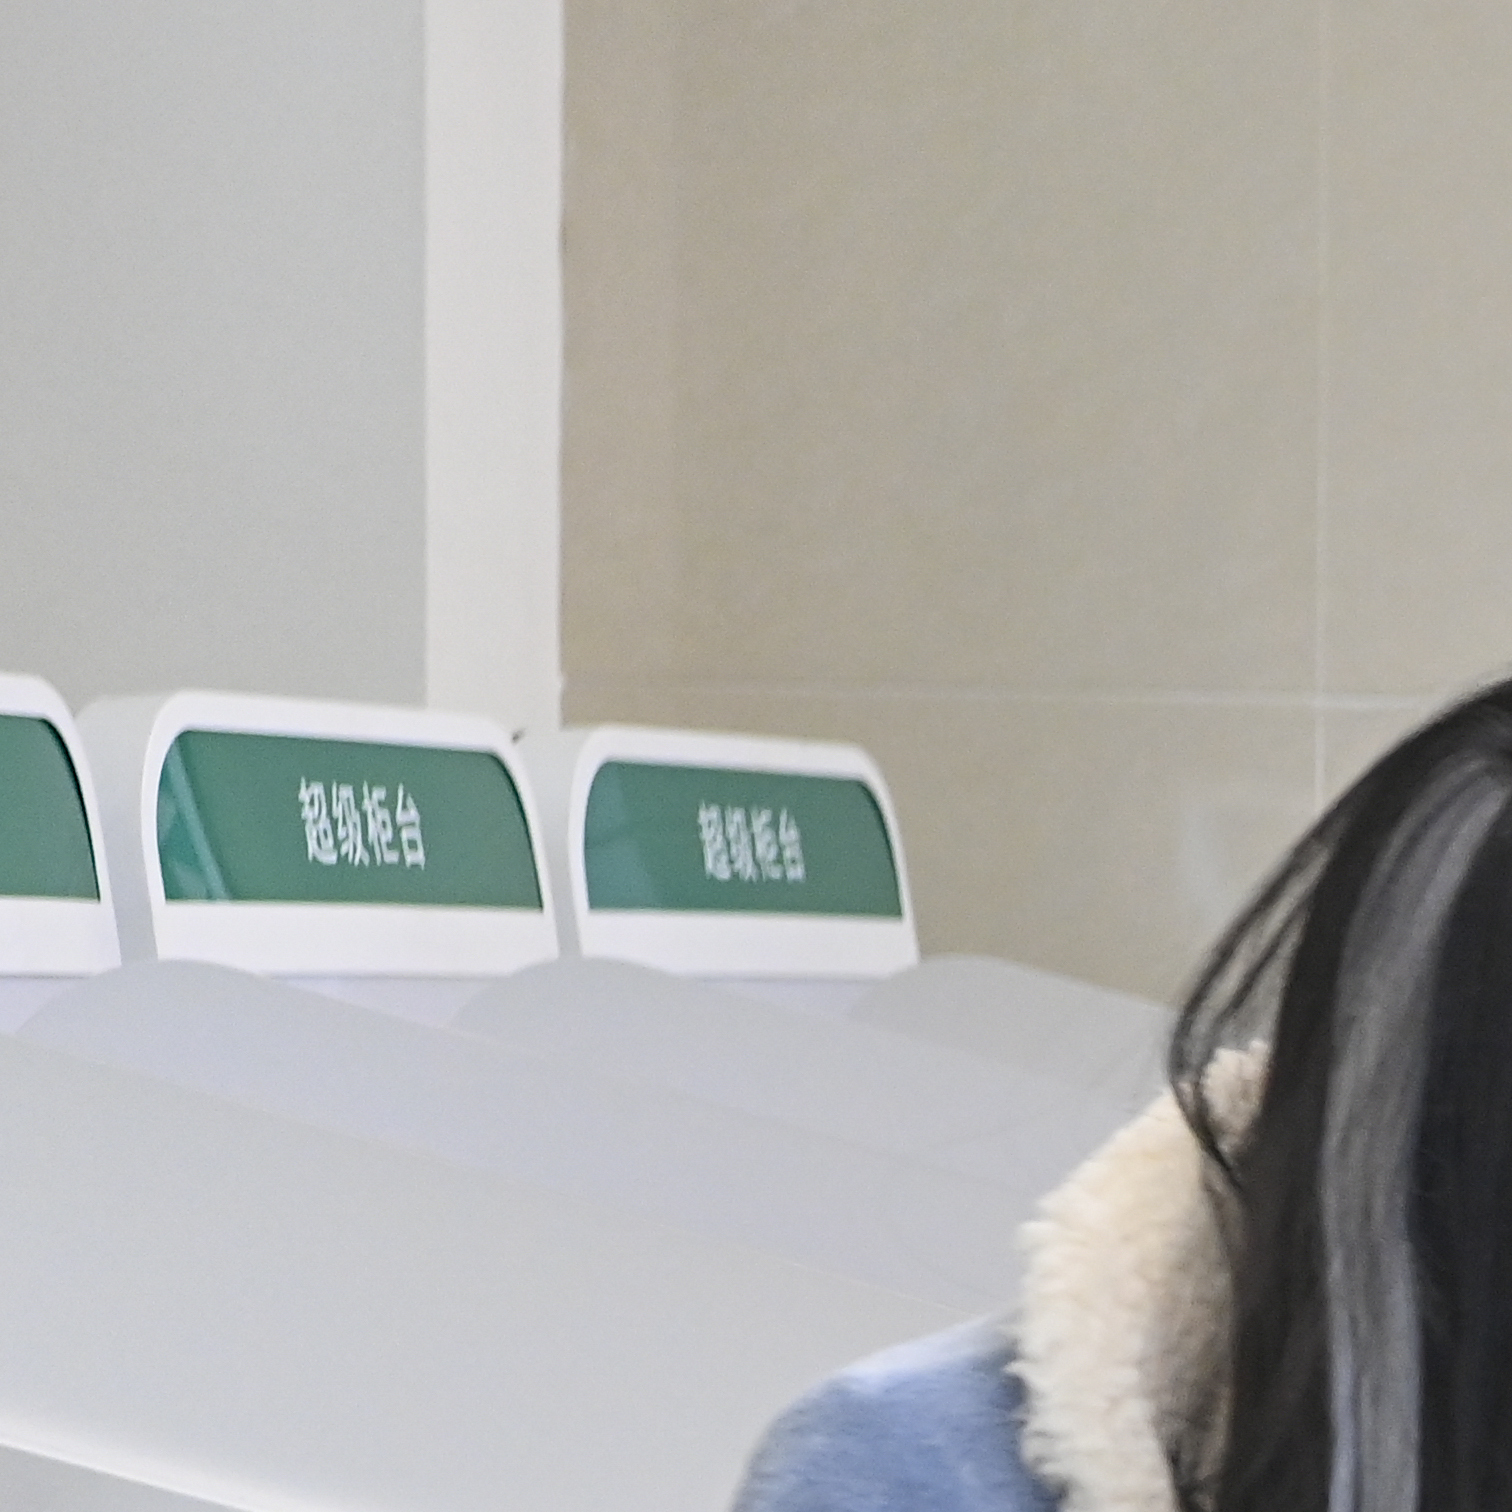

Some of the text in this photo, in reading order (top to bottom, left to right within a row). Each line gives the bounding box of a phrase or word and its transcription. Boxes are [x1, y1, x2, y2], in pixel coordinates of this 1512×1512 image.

[299, 778, 425, 870] 超级柜台
[699, 801, 806, 883] 超级柜台
